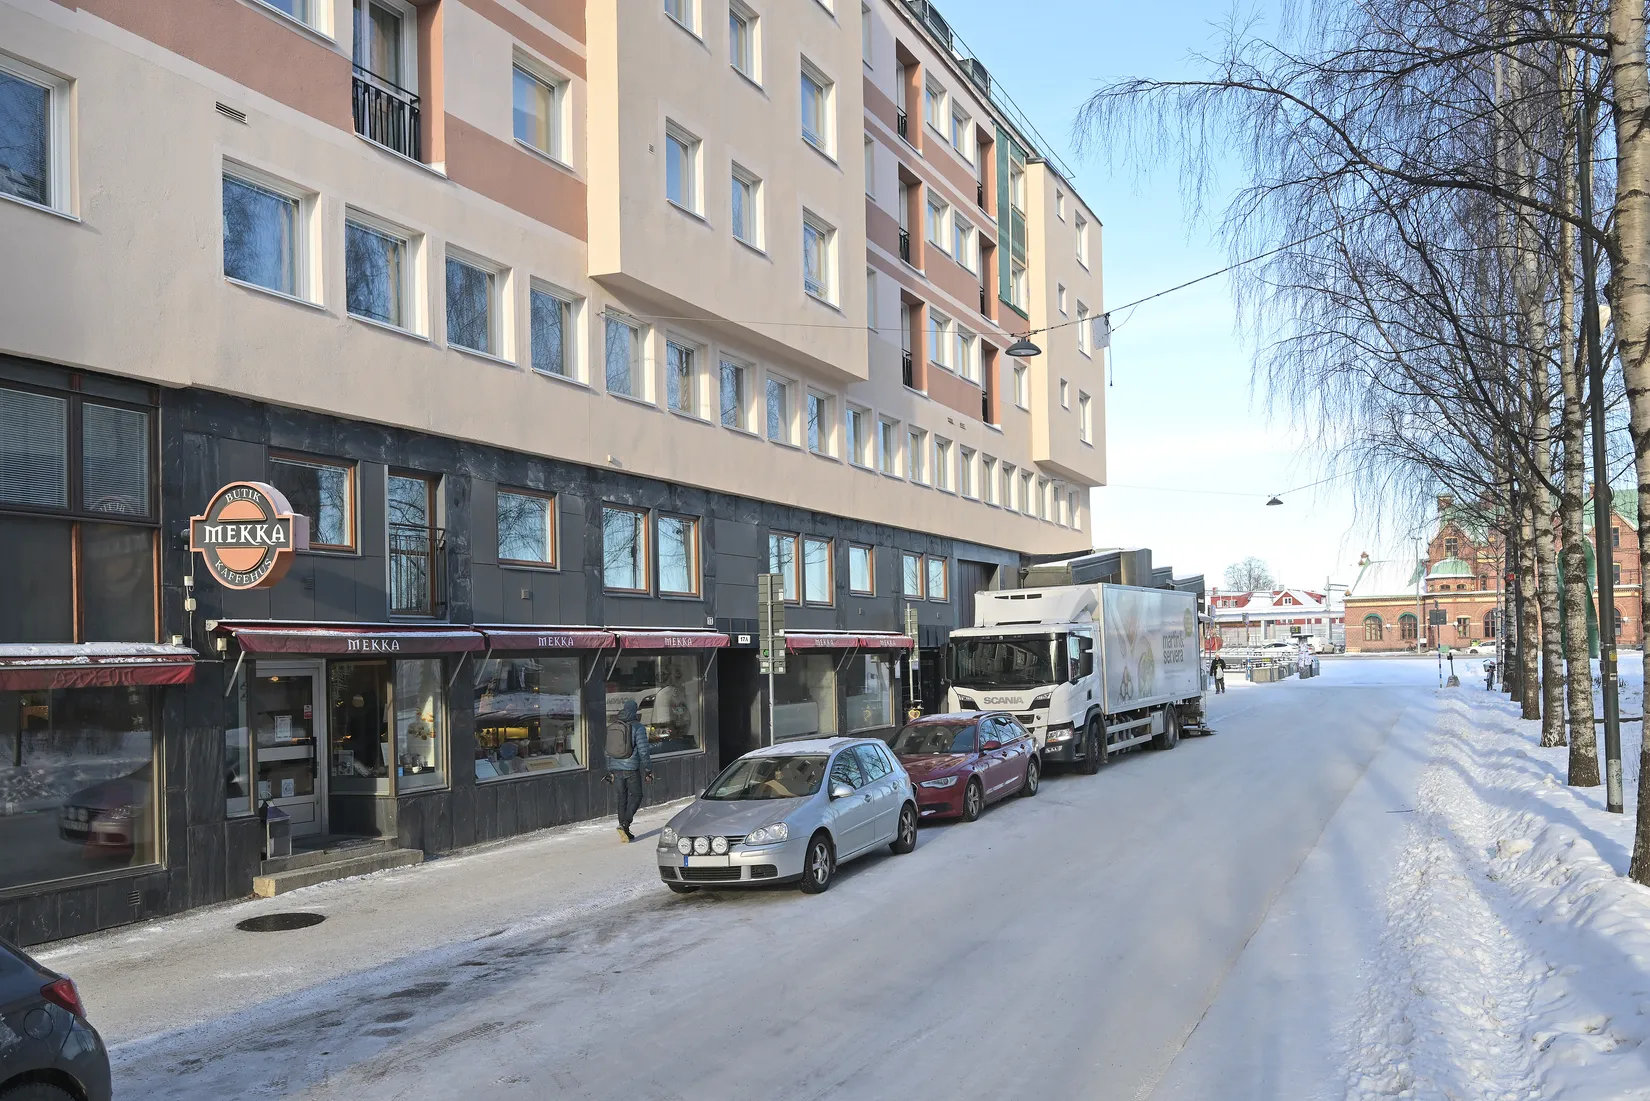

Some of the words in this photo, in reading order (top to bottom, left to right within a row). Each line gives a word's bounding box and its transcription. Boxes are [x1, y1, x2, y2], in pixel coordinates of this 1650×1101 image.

[225, 488, 262, 503] BUTIK
[203, 524, 286, 546] MEKKA
[215, 558, 272, 584] KAFFEHUS
[346, 638, 400, 653] MEKKA
[538, 636, 574, 648] MEKKA
[664, 637, 693, 647] MEKKA
[814, 638, 835, 647] MEKKA
[1163, 649, 1184, 664] servera
[983, 696, 1024, 705] SCANIA
